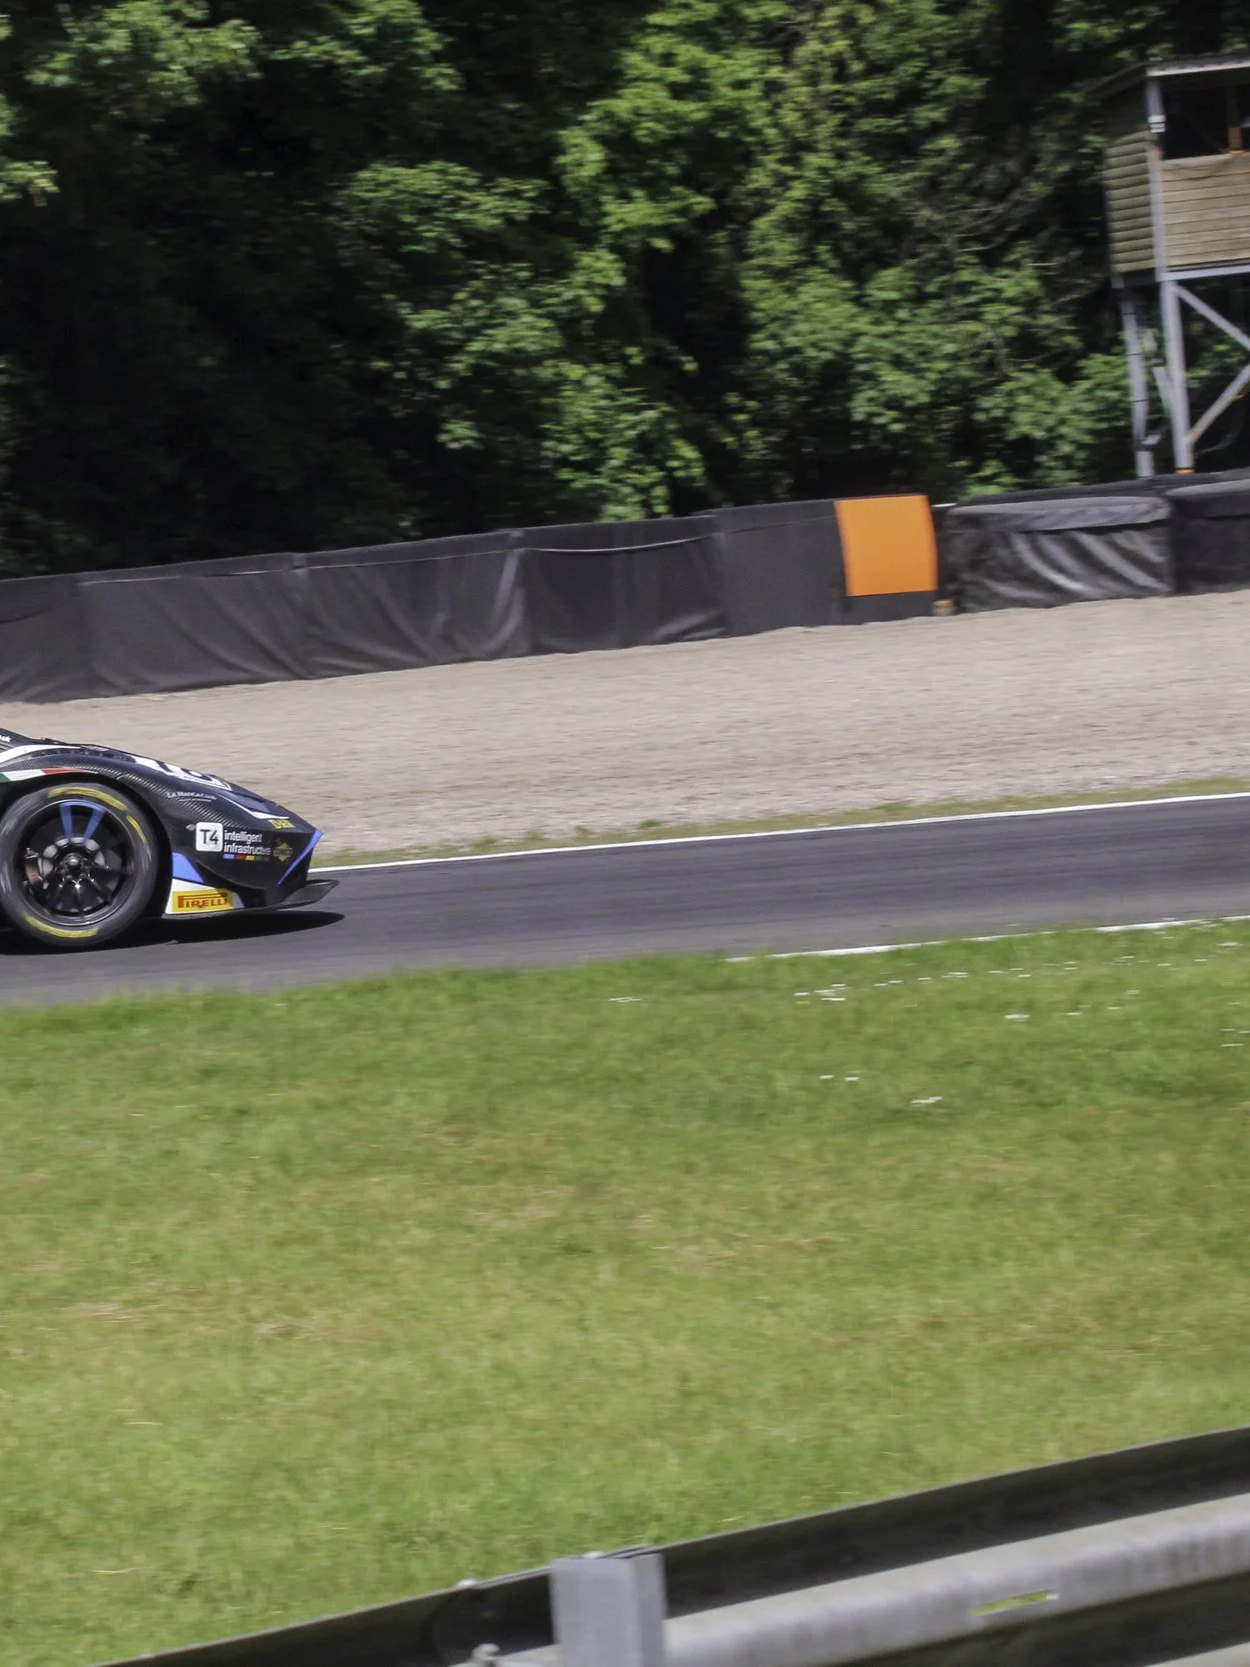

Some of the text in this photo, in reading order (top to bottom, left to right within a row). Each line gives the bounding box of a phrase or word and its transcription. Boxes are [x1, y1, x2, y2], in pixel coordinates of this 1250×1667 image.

[199, 829, 219, 845] T4
[224, 830, 263, 843] intelligent
[177, 892, 228, 909] PIRELLI
